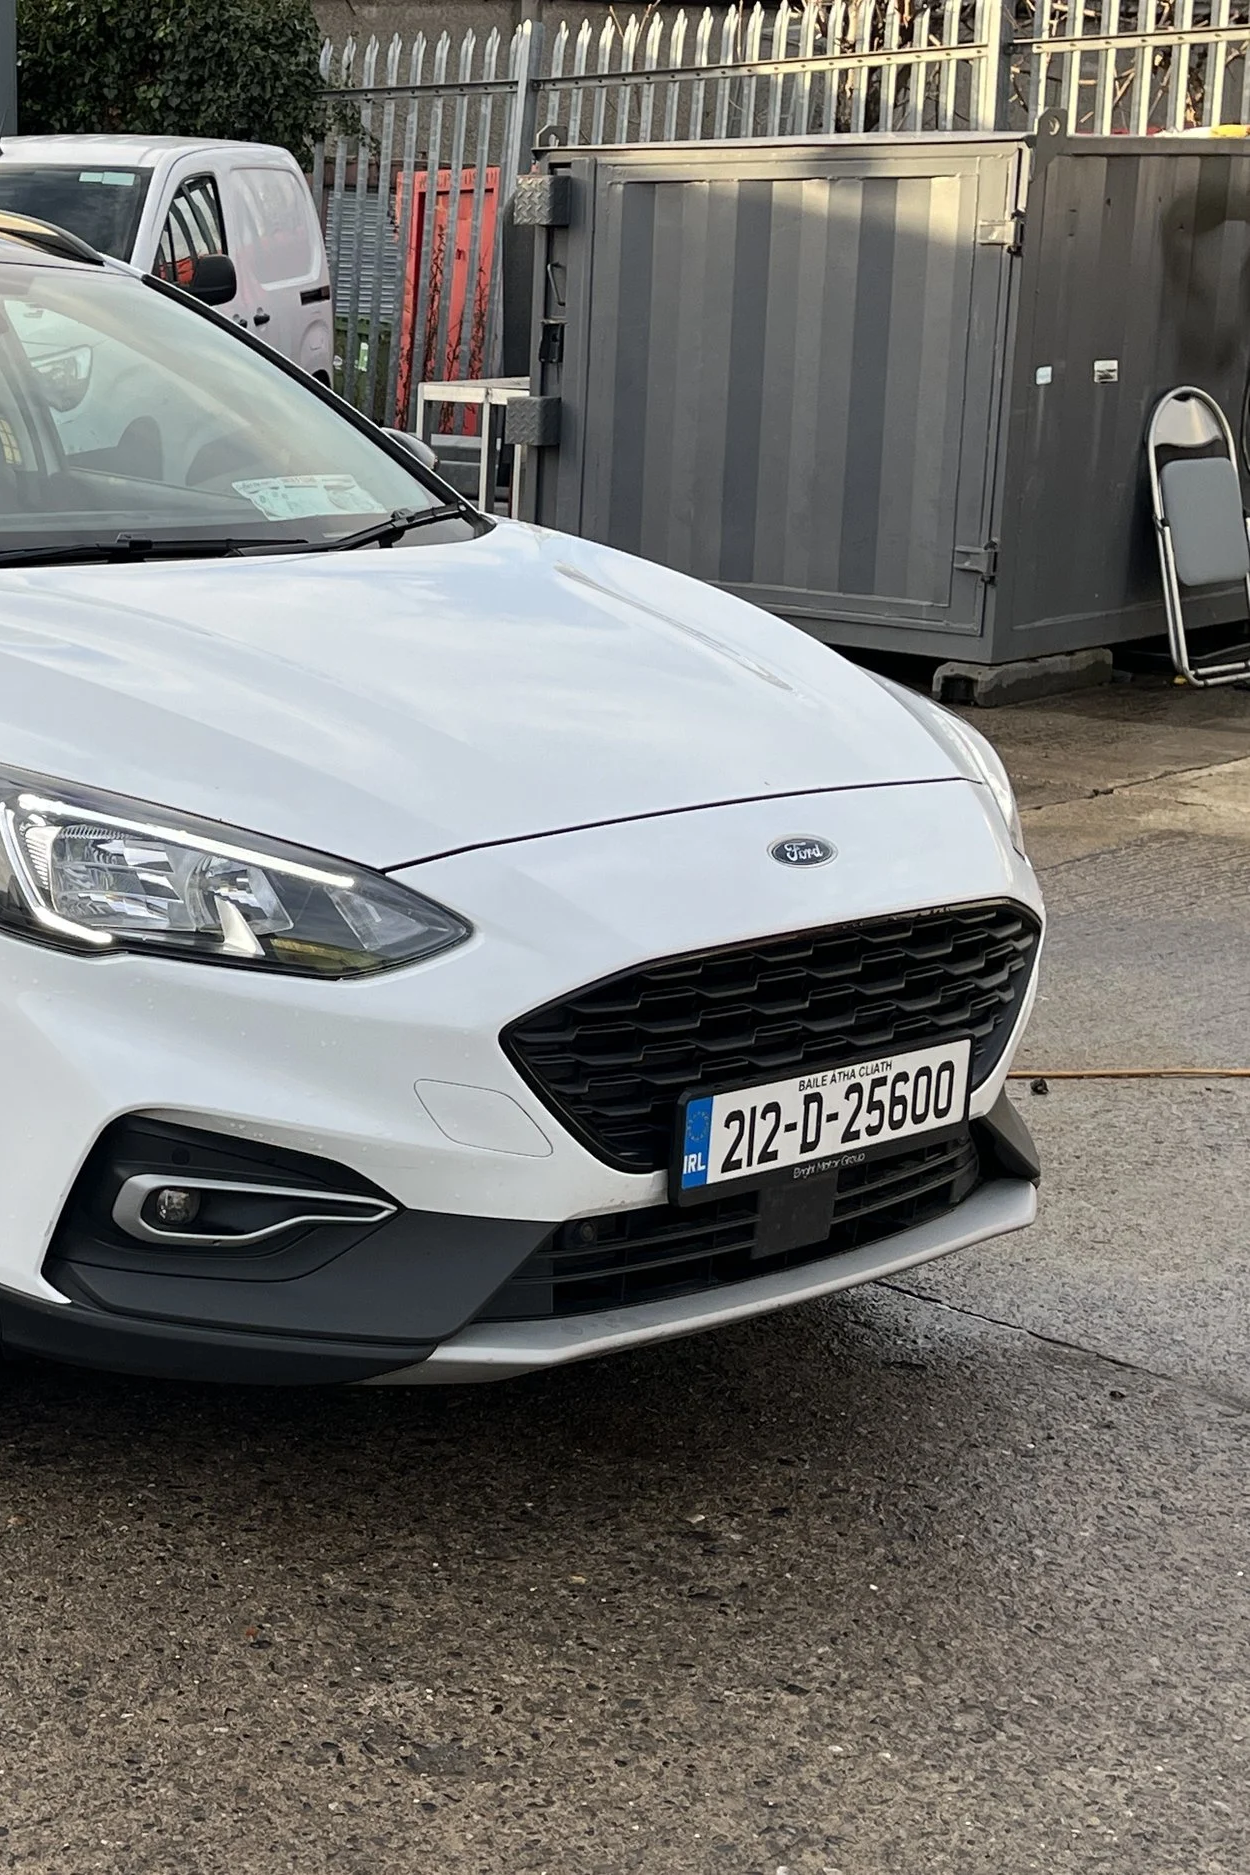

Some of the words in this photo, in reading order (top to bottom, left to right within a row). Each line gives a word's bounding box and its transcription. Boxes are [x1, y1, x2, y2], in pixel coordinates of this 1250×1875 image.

[784, 842, 824, 861] Ford
[798, 1075, 828, 1091] BAILE
[858, 1061, 892, 1077] CLIATH
[720, 1060, 955, 1174] 212-D-25600
[683, 1152, 706, 1174] IRL
